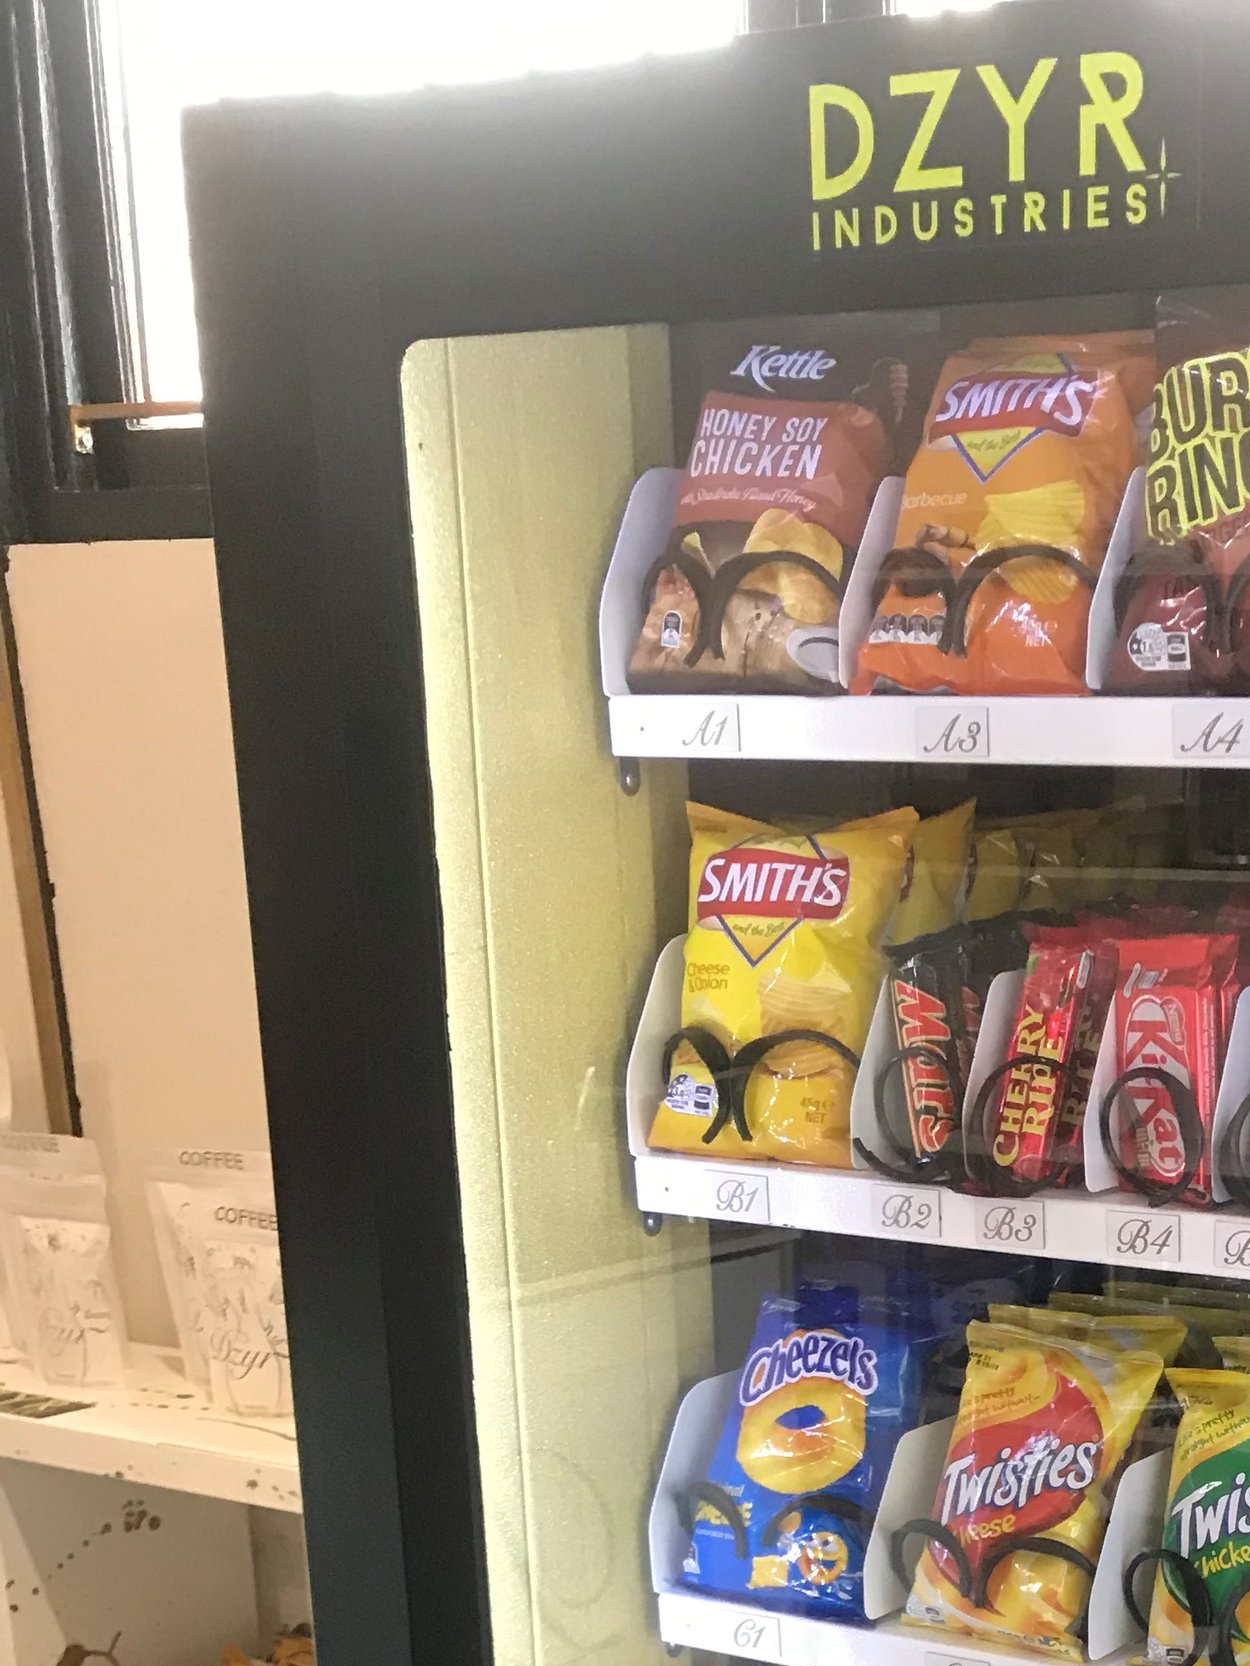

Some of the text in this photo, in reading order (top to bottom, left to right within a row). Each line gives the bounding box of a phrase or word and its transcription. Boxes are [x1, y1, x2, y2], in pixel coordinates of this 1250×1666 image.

[809, 51, 1146, 201] DZYR
[812, 184, 1148, 251] INDUSTRIES
[730, 345, 836, 392] Kettle
[701, 408, 828, 443] HONEY SOY
[690, 440, 822, 480] CHICKEN
[682, 709, 729, 747] A1
[923, 713, 981, 753] A3
[1180, 711, 1245, 754] A4
[698, 857, 848, 907] SMITH'S
[992, 1004, 1044, 1167] CHERRY
[1022, 1036, 1064, 1136] RIPE
[178, 1150, 245, 1171] COFFEE
[716, 1179, 759, 1213] B1
[881, 1193, 933, 1230] B2
[214, 1205, 278, 1231] COFFEE
[982, 1204, 1039, 1243] B3
[1115, 1217, 1174, 1257] B4
[740, 1332, 878, 1407] Cheezels
[941, 1438, 1099, 1527] Twisties
[958, 1514, 1017, 1547] heese
